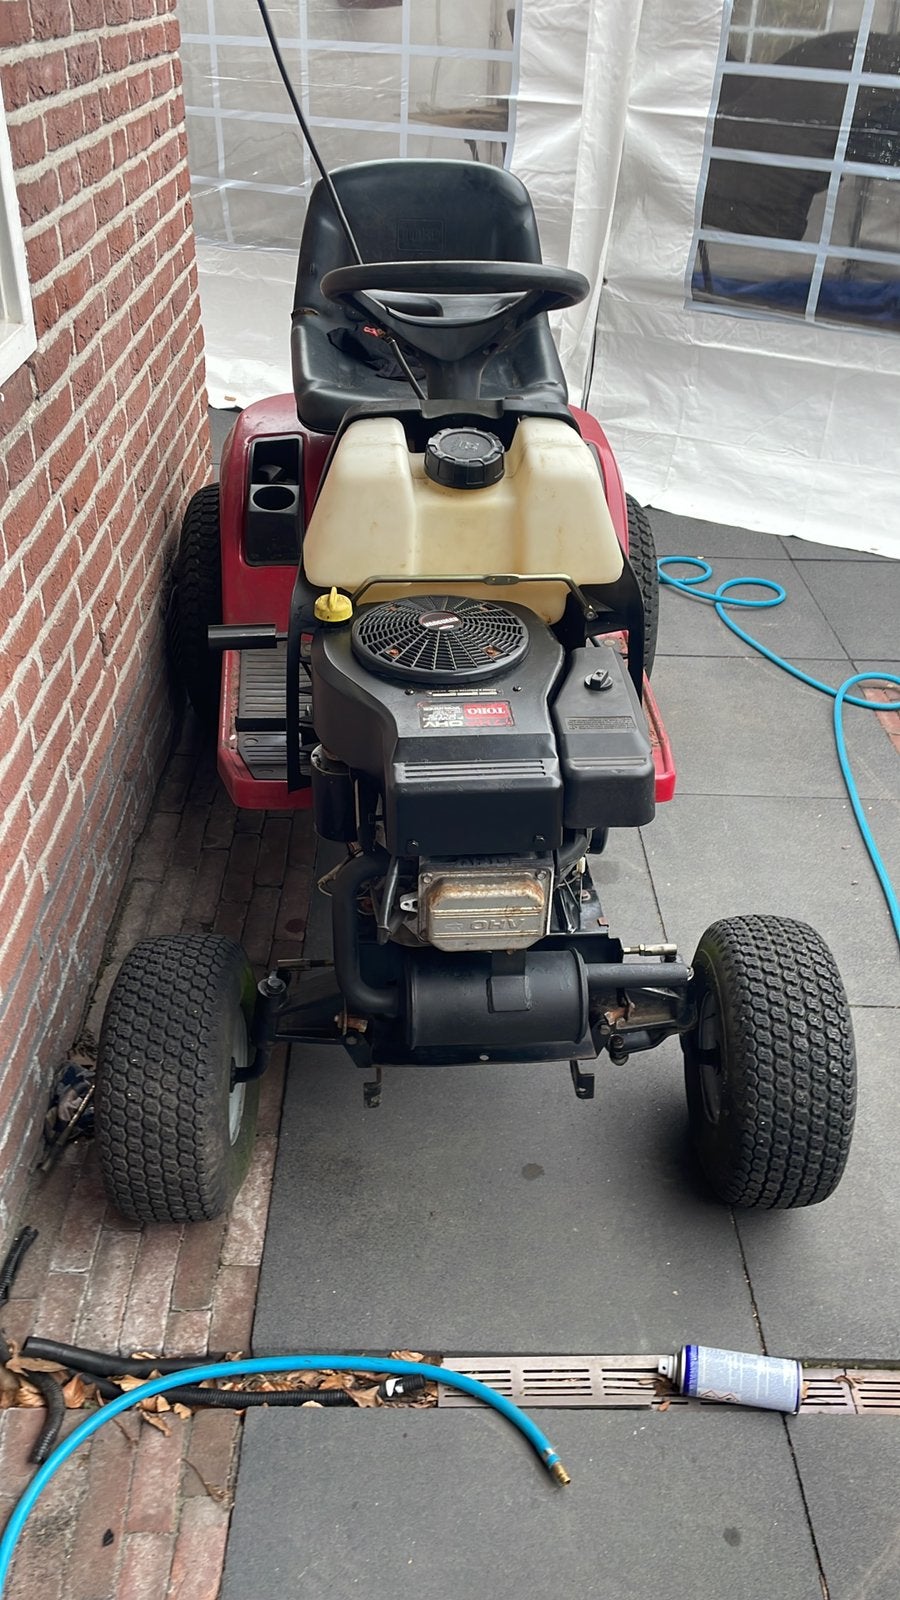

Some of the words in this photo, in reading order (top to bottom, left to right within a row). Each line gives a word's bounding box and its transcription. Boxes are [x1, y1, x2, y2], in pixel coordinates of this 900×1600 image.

[467, 707, 506, 715] TORO
[423, 720, 464, 728] OHV
[470, 918, 525, 930] OHV
